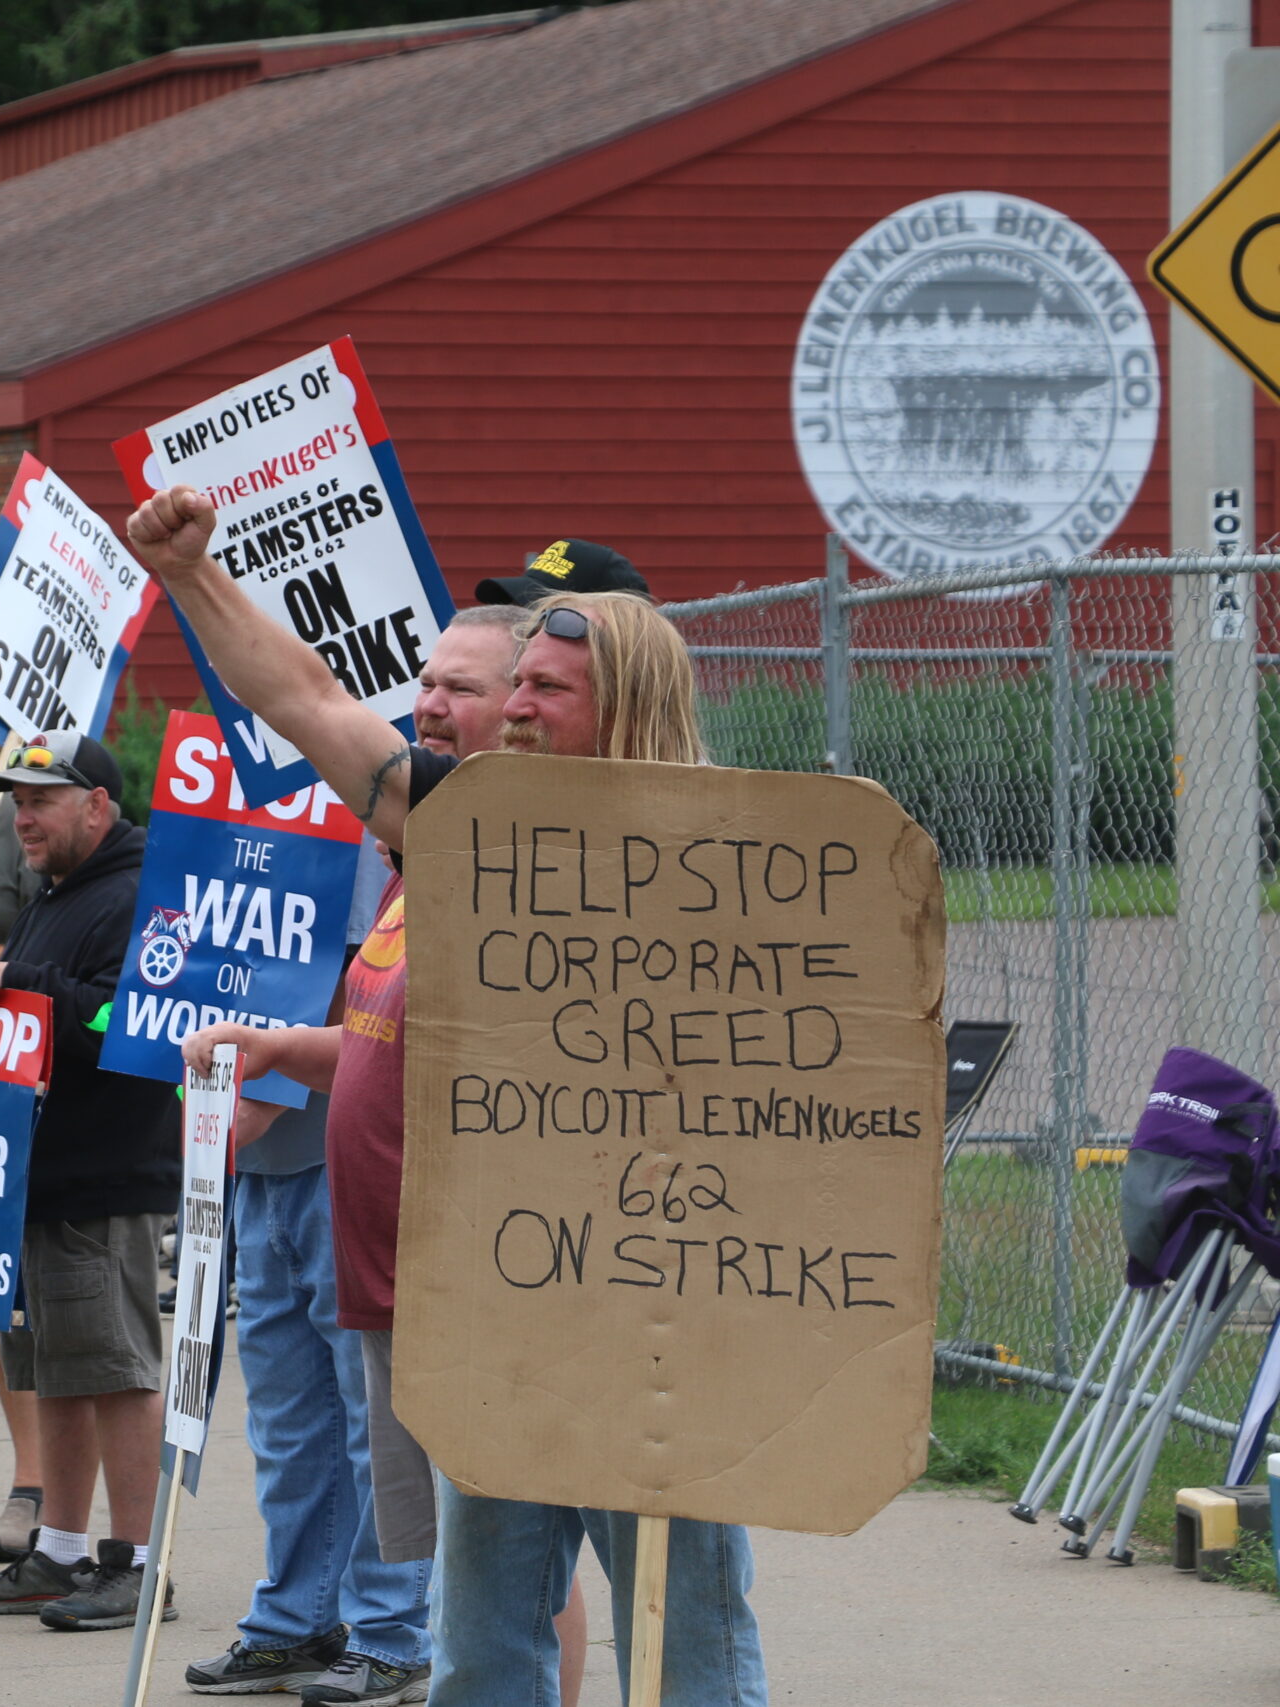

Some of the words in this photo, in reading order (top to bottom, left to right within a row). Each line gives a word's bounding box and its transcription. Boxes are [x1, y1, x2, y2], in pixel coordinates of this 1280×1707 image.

[995, 200, 1137, 335] BREWING
[1120, 349, 1153, 420] CO.
[162, 384, 296, 465] EMPLOYEES
[300, 365, 331, 400] OF
[42, 483, 117, 571] EMPLOYEES
[118, 566, 139, 593] OF
[226, 490, 313, 540] MEMBERS
[317, 478, 341, 498] OF
[39, 561, 89, 614] MEMBERS
[49, 531, 112, 611] LEINIE'S
[260, 553, 310, 583] LOCAL
[314, 537, 346, 559] 662
[12, 556, 106, 670] TEAMSTERS
[38, 601, 67, 634] LOCAL
[283, 561, 358, 644] ON
[31, 623, 74, 694] ON
[314, 605, 428, 702] RIKE
[233, 837, 274, 872] THE
[471, 817, 661, 918] HELP
[677, 837, 859, 917] STOP
[185, 873, 317, 964] WAR
[216, 963, 252, 997] ON
[478, 929, 859, 996] CORPORATE
[552, 998, 843, 1071] GREED
[221, 1061, 233, 1093] OF
[451, 1074, 669, 1139] BOYCOTT
[678, 1087, 922, 1144] LEINENKUGELS
[186, 1197, 222, 1239] TEAMSTERS
[619, 1151, 743, 1224] 662
[494, 1209, 593, 1289] ON
[608, 1234, 898, 1311] STRIKE
[174, 1336, 211, 1421] STRIKE
